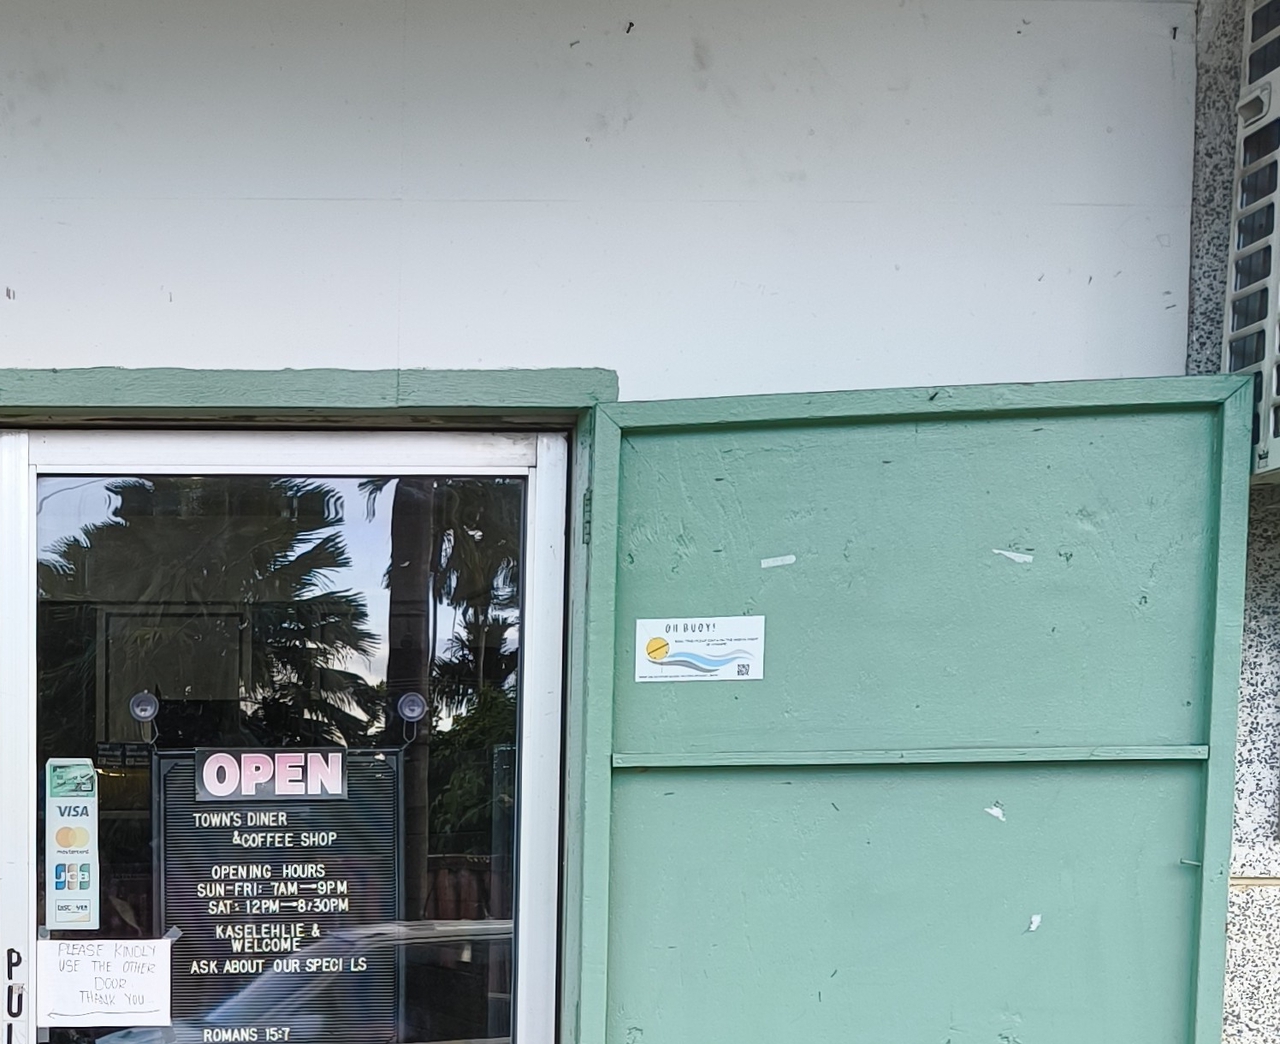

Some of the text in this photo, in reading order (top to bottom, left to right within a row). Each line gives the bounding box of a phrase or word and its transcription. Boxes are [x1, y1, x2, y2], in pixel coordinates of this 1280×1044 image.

[683, 622, 716, 633] BUOY!
[203, 752, 342, 796] OPEN
[56, 805, 89, 817] VISA
[193, 812, 288, 827] TOWN'S DINER
[301, 832, 337, 846] SHOP
[211, 864, 326, 880] OPENING HOURS
[208, 900, 240, 915] SAT:
[216, 923, 320, 939] KASELEHLIE &
[58, 942, 156, 959] PLEASE KINDLY
[231, 938, 302, 953] WELCOME
[59, 960, 156, 974] USE THE OTHER
[190, 960, 218, 974] ASK
[223, 959, 265, 974] ABOUT
[273, 959, 301, 973] OUR
[94, 976, 127, 991] DOOR
[79, 990, 145, 1006] THANK YOU
[203, 1027, 291, 1043] ROMANS 15:7
